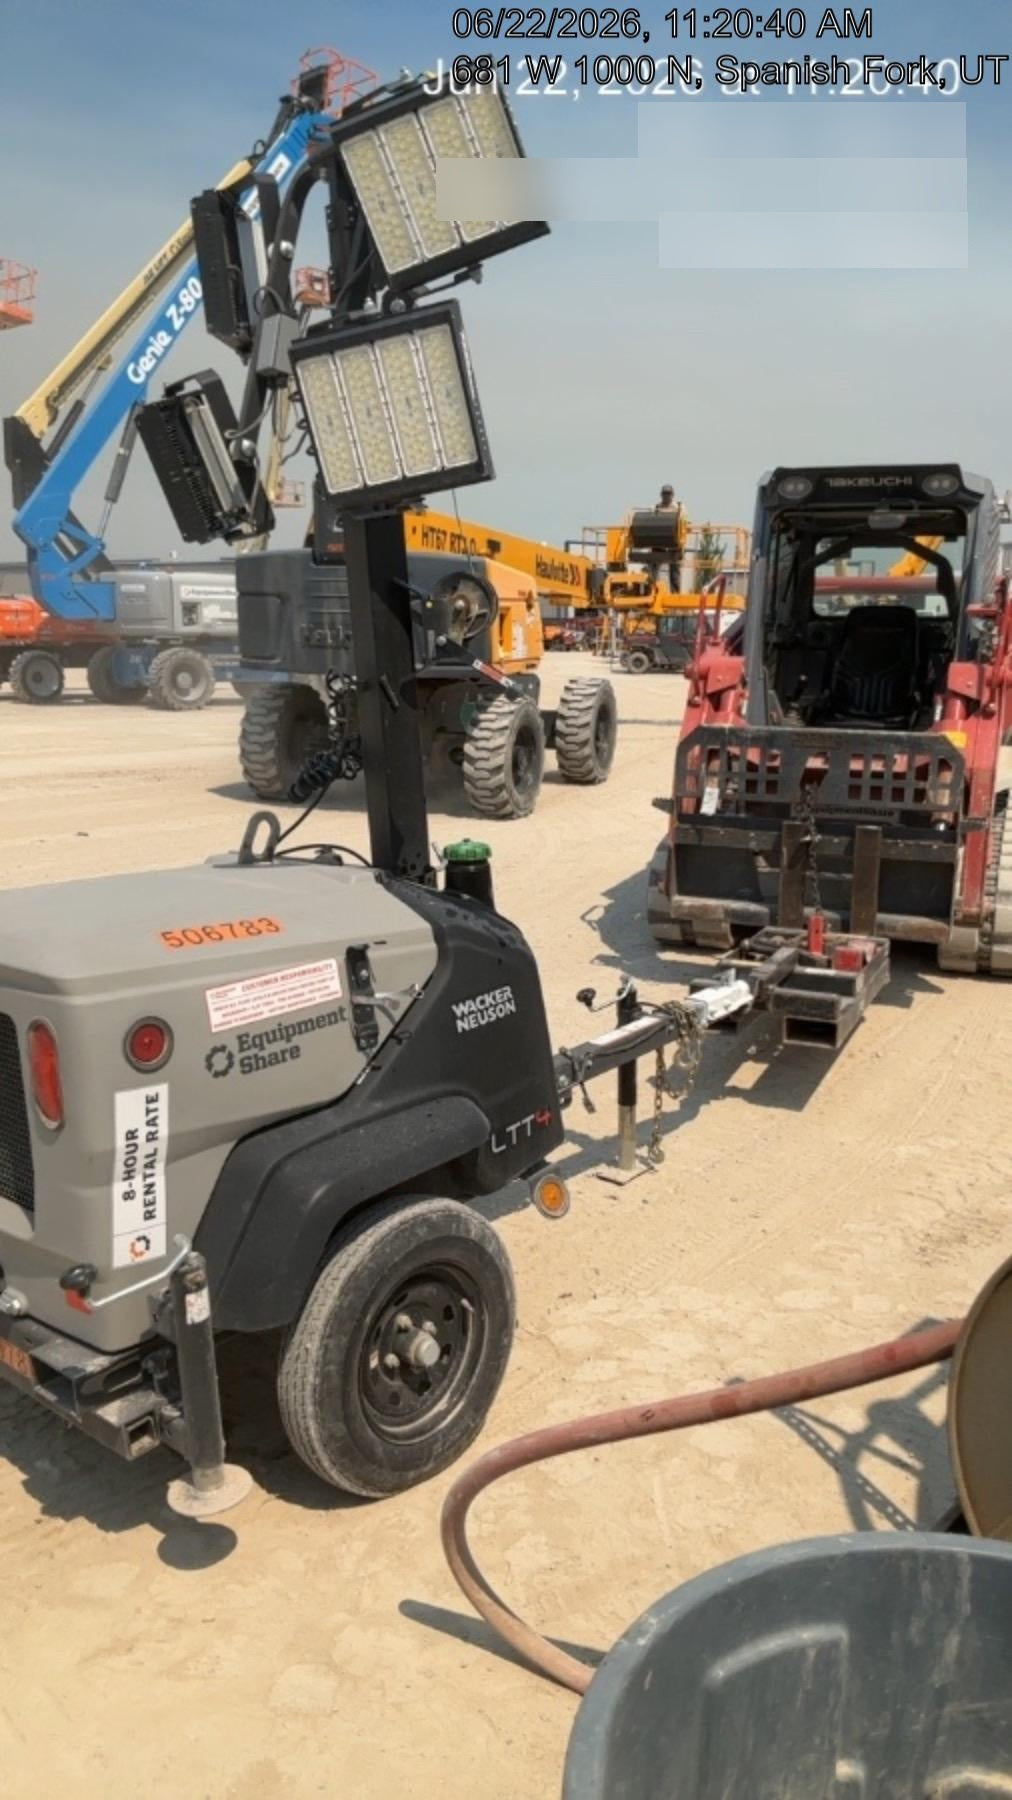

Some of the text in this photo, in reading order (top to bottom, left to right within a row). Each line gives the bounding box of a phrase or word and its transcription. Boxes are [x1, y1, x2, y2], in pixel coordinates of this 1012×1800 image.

[127, 330, 173, 384] Genie
[165, 276, 203, 331] Z-80
[160, 916, 281, 949] 506783
[451, 985, 513, 1018] WACKER
[456, 1000, 517, 1033] NEUSON
[236, 1006, 348, 1053] Equipment
[239, 1045, 301, 1076] Share
[122, 1127, 139, 1202] 8-HOUR
[142, 1092, 160, 1222] RENTAL RATE
